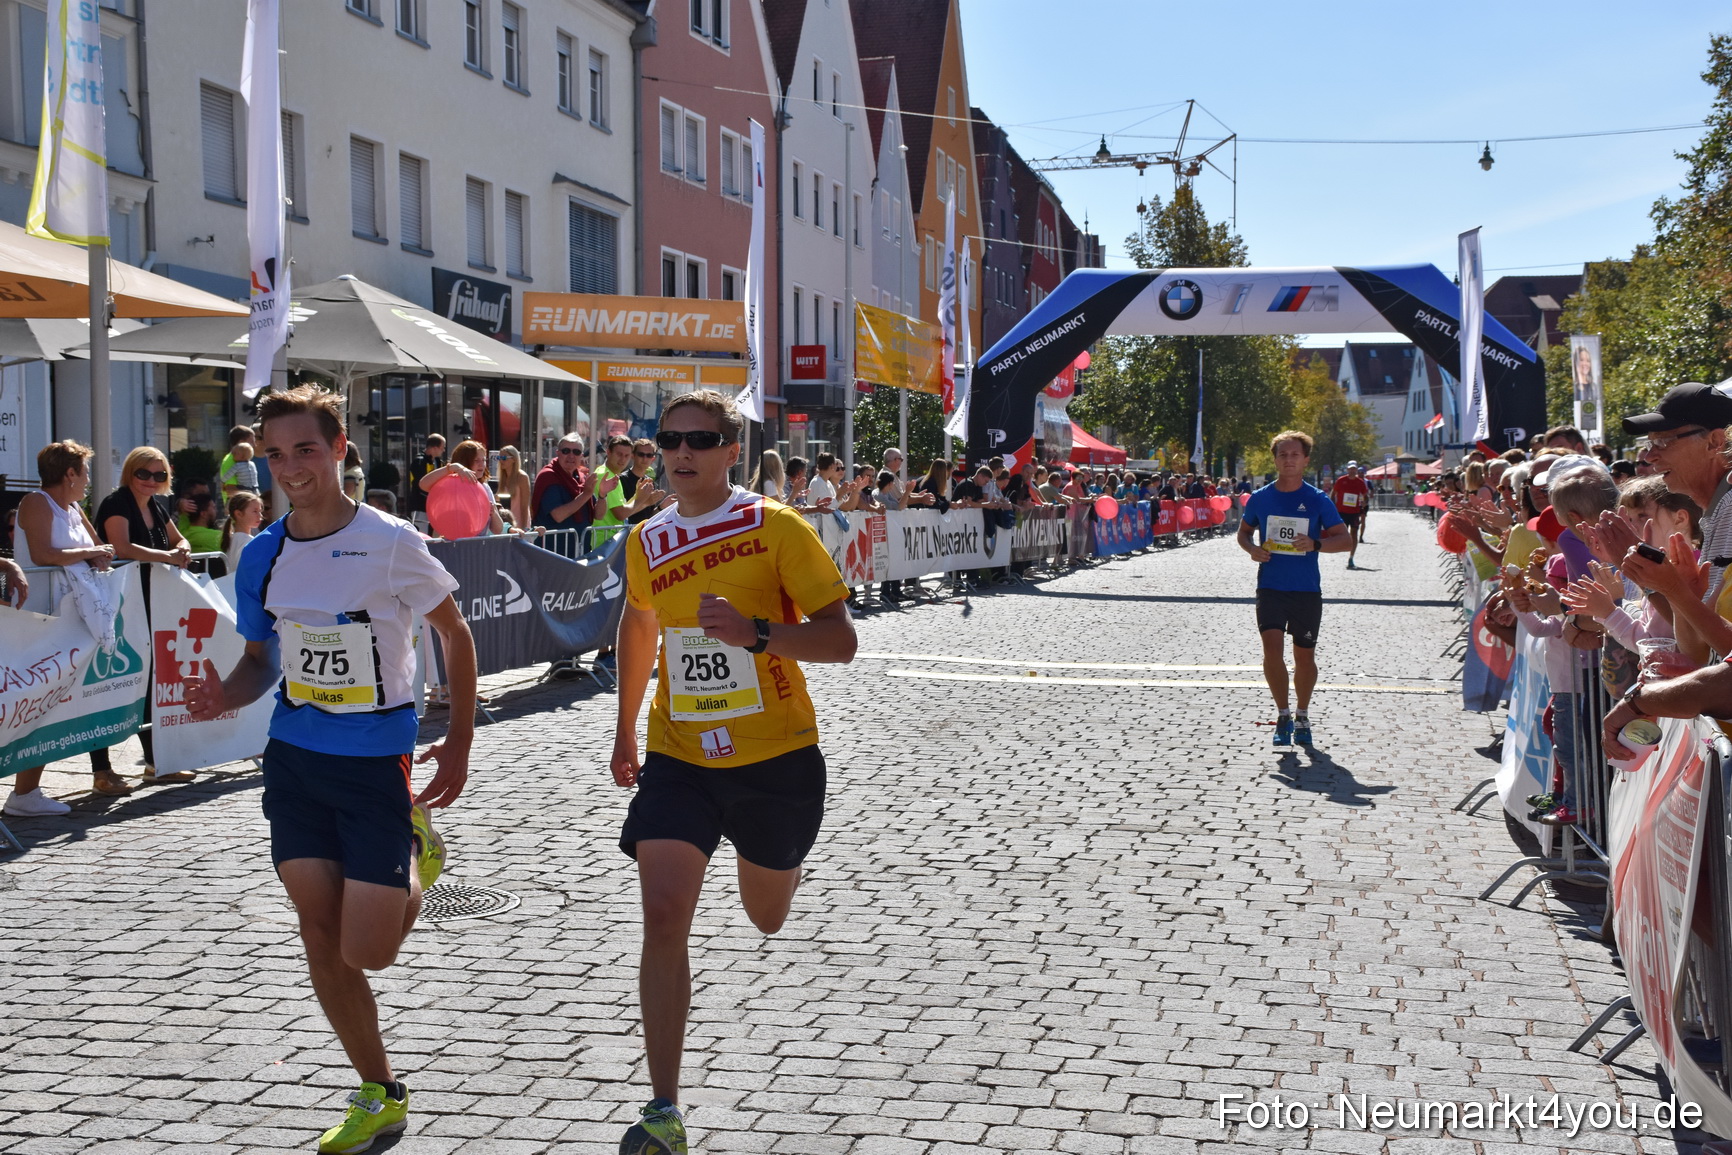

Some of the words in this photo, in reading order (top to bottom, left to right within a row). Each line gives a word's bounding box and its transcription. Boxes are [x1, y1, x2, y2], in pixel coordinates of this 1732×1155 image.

[529, 306, 736, 338] RUNMARKT.DE
[990, 351, 1027, 376] PARTL
[1025, 312, 1087, 355] NEUMARKT
[1414, 309, 1452, 339] PARTL
[1453, 330, 1523, 370] NMARKT
[796, 356, 819, 365] WITT
[607, 366, 687, 379] RUNMARKT.DE
[1279, 527, 1294, 539] 69
[651, 560, 698, 596] MAX
[703, 538, 768, 570] BÖGL
[302, 631, 342, 643] BOCK
[300, 648, 350, 676] 275
[681, 652, 730, 682] 258
[157, 682, 184, 704] DKM
[312, 689, 344, 703] Lukas
[701, 684, 728, 692] Neumarkt
[695, 698, 728, 711] Julian
